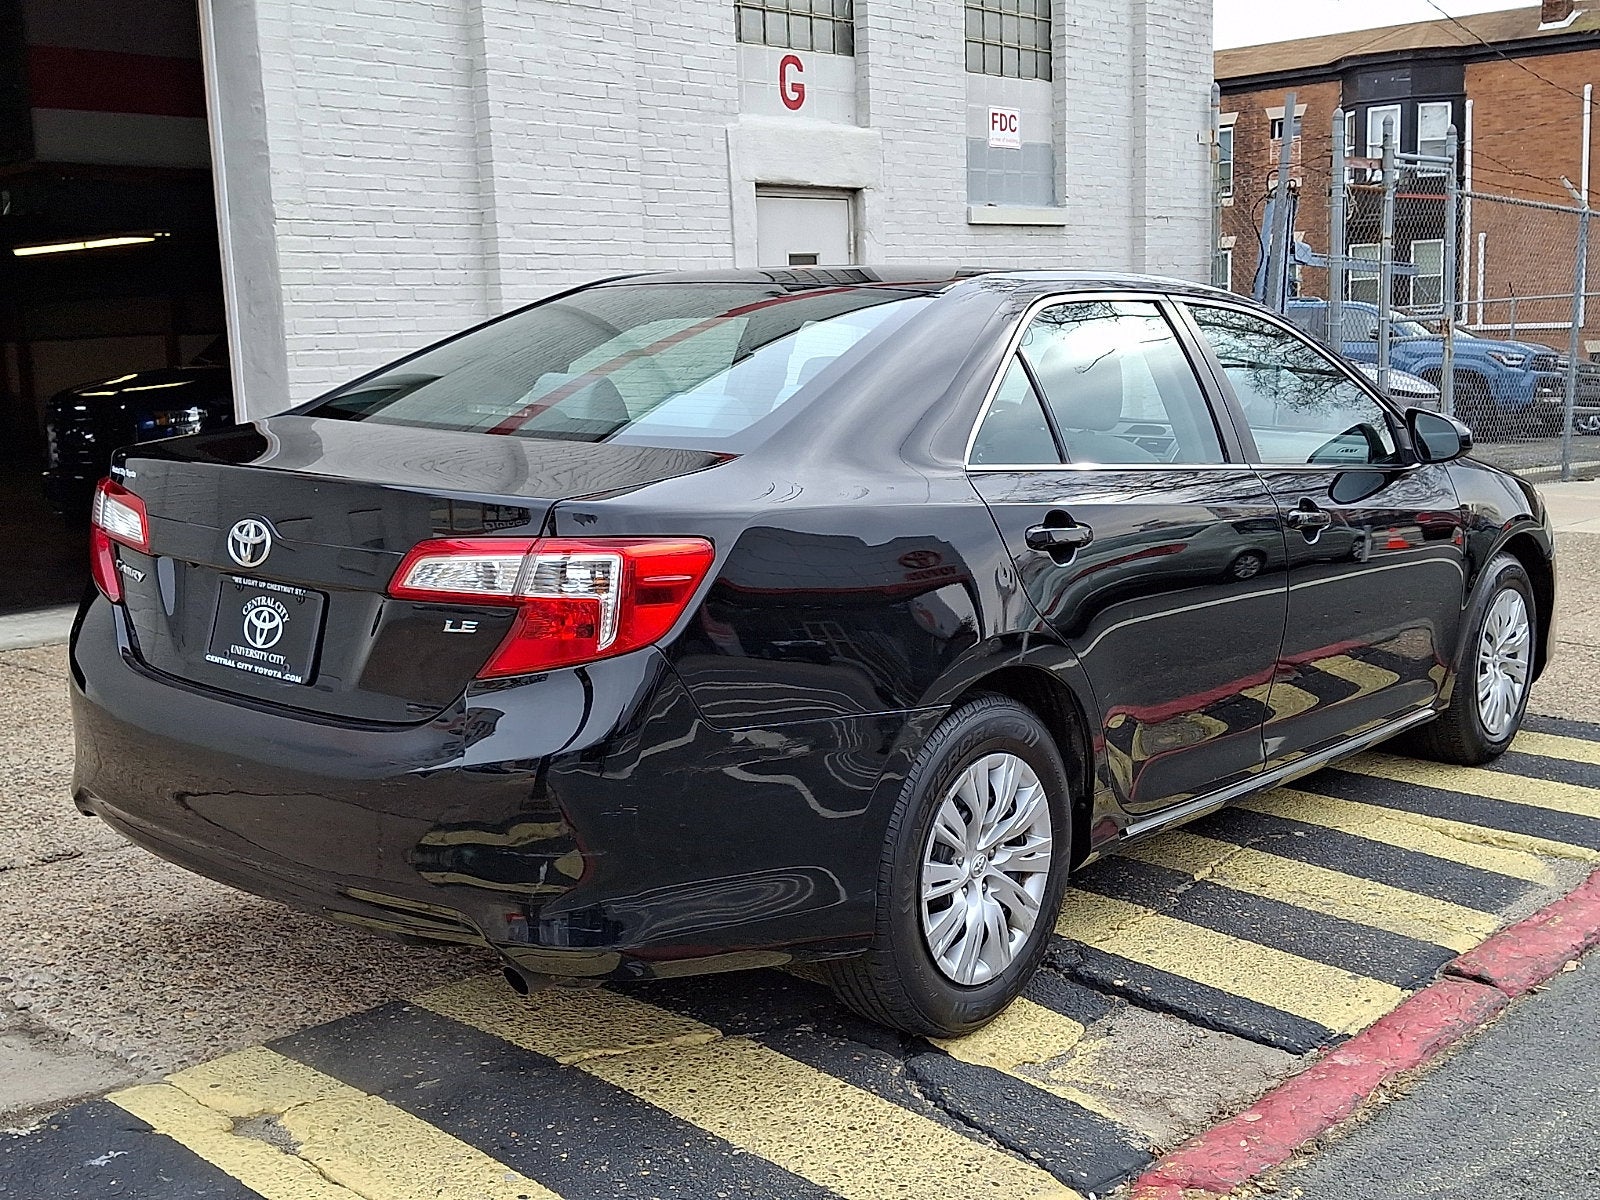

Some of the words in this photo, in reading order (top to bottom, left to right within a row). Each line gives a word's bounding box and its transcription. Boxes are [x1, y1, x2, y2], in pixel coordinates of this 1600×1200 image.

[779, 54, 806, 111] G
[991, 112, 1017, 133] FDC
[243, 578, 258, 587] LIGHT
[258, 580, 266, 588] UP
[266, 582, 294, 594] CHESTNUT
[242, 595, 276, 616] CENTRAL
[275, 600, 290, 623] CITY
[442, 619, 479, 633] LE
[230, 644, 269, 663] UNIVERSITY
[268, 653, 287, 665] CITY
[205, 654, 235, 667] CENTRAL
[236, 661, 254, 672] CITY
[254, 666, 282, 678] TOYOTA
